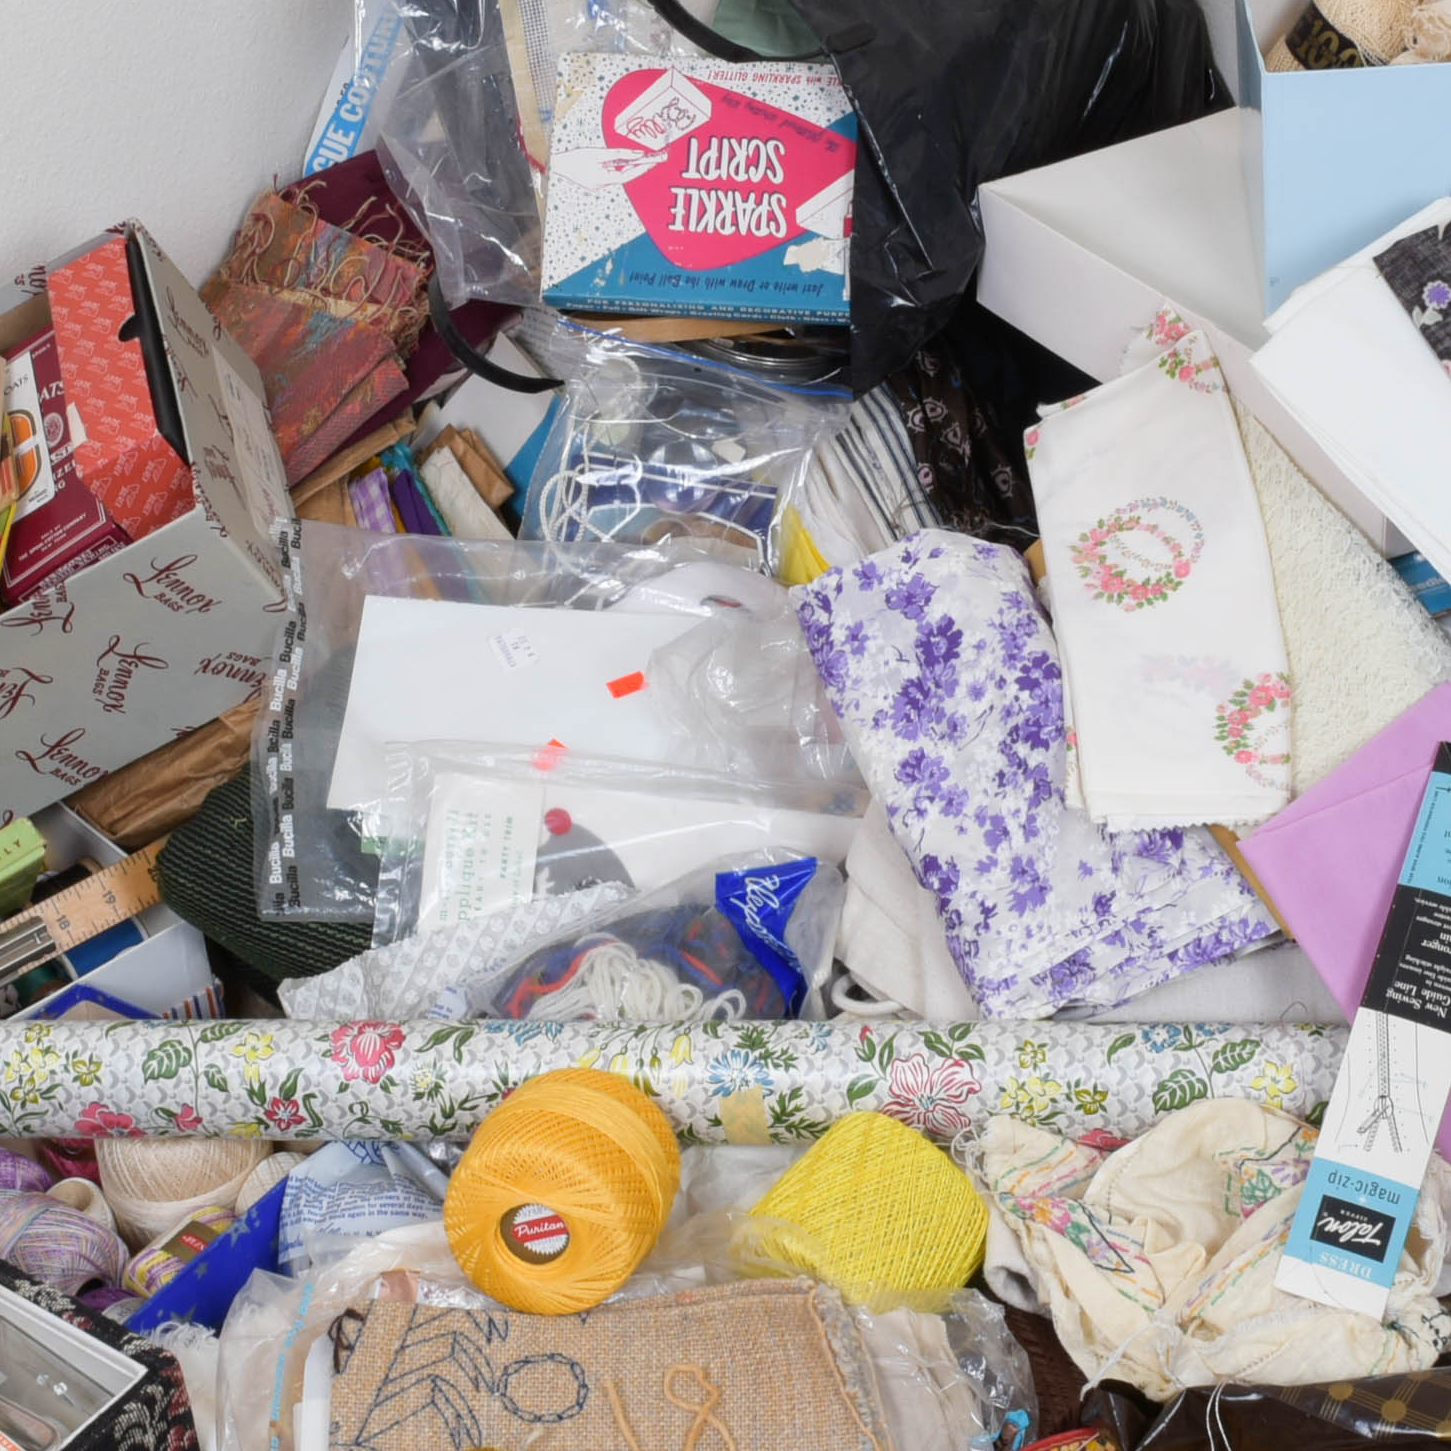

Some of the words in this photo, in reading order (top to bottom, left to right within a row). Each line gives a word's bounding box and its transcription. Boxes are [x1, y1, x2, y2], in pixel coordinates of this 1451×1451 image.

[707, 70, 749, 82] GLITTER!
[761, 71, 802, 84] SPARKLING
[681, 135, 786, 185] SCRIPT
[668, 186, 788, 239] SPARKLE
[629, 271, 657, 286] Point
[658, 273, 683, 288] Ball
[685, 274, 701, 286] the
[705, 276, 727, 291] with
[729, 278, 755, 293] Draw
[760, 281, 770, 290] or
[771, 279, 801, 294] write
[801, 282, 825, 298] Just
[3, 373, 30, 396] OATS
[39, 380, 66, 403] ATS
[122, 554, 223, 614] Lennox
[153, 591, 184, 613] BAGS
[279, 620, 297, 664] Bucilla
[226, 651, 261, 667] BAGS
[96, 634, 169, 715] Lennox
[286, 646, 305, 692] Bucilla
[92, 667, 110, 696] BAGS
[269, 667, 288, 712] Bucilla
[281, 698, 296, 741] Bucilla
[48, 767, 81, 787] BAGS
[279, 813, 296, 859] Bucilla
[268, 840, 284, 885] Bucilla
[457, 847, 475, 921] pplique
[101, 889, 118, 906] 19
[55, 914, 72, 932] 18
[1415, 915, 1443, 929] stronger
[1404, 953, 1433, 968] stitching
[1422, 969, 1436, 980] line
[1385, 986, 1423, 1010] Sewing
[1393, 980, 1418, 997] Line
[1420, 988, 1451, 1007] Guide
[1424, 1002, 1449, 1019] New
[1327, 1169, 1402, 1205] magic-zip
[513, 1220, 565, 1238] Puritan
[1316, 1215, 1384, 1247] Talon
[1318, 1251, 1374, 1280] DRESS
